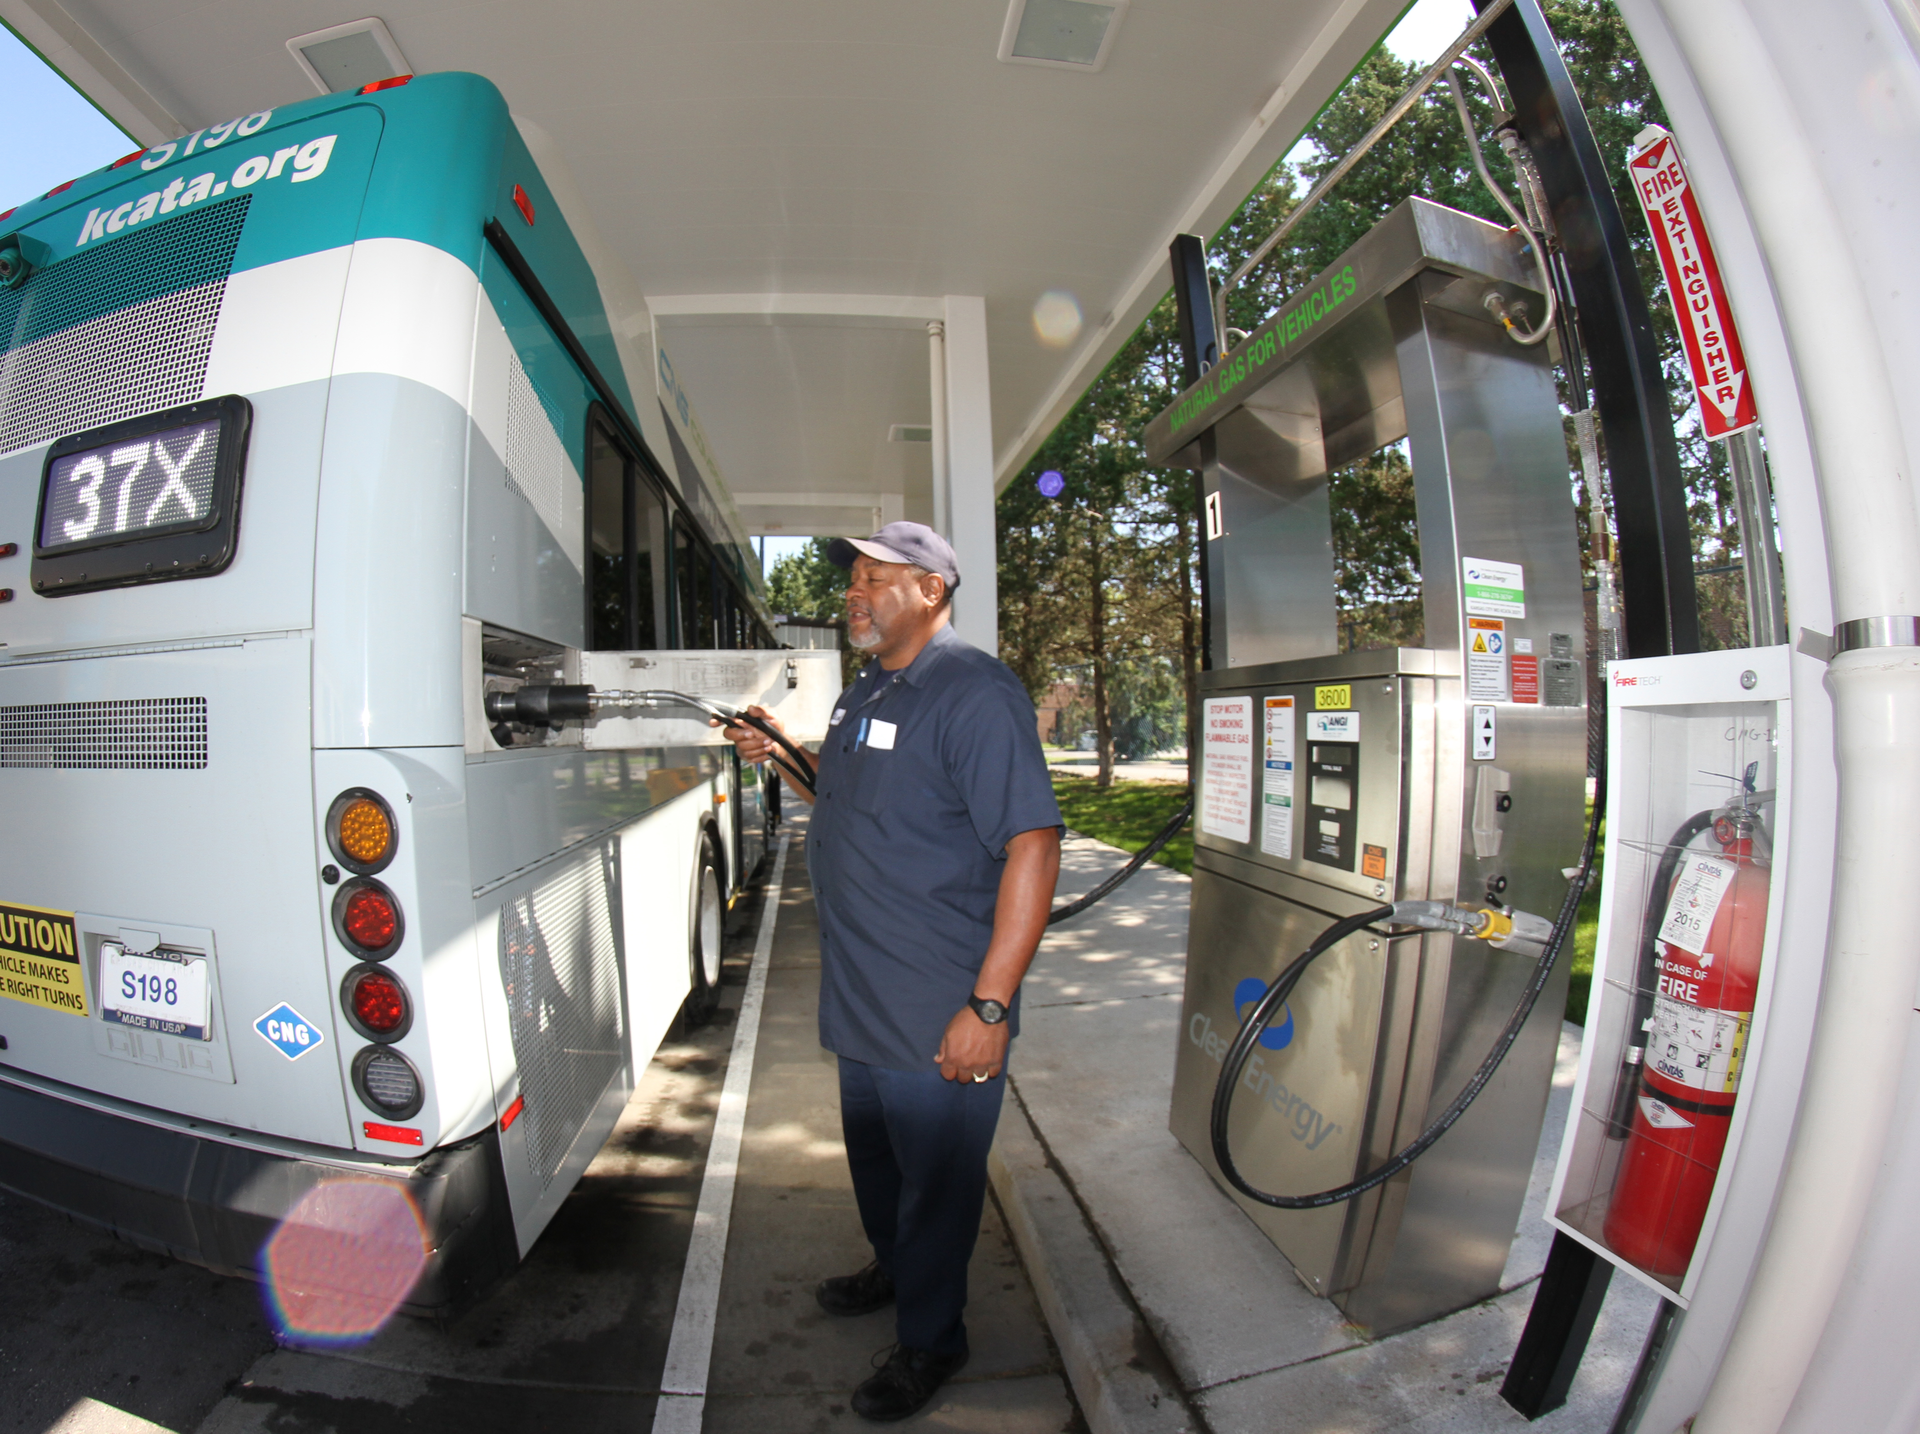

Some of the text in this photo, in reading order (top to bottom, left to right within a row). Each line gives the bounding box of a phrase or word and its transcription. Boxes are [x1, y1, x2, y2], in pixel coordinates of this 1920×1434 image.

[76, 134, 338, 247] kcata.org
[1641, 161, 1684, 205] FIRE
[1662, 196, 1736, 405] EXTINGUISHER
[1169, 265, 1357, 434] NATURAL GAS FOR VEHICLES
[63, 427, 207, 541] 37X
[1208, 494, 1219, 536] 1
[1210, 704, 1243, 714] STOP MOTOR
[1318, 688, 1347, 706] 3600
[1210, 719, 1243, 728] NO SMOKING
[1328, 716, 1348, 726] ANGI
[1205, 732, 1249, 744] FLAMMABLE GAS
[0, 912, 74, 956] UTION
[1673, 911, 1702, 931] 2015
[124, 946, 181, 961] GLIG
[28, 961, 70, 984] MAKES
[1654, 958, 1709, 981] IN CASE OF
[7, 978, 40, 1000] RIGHT
[41, 986, 84, 1010] TURNS
[121, 970, 178, 1005] S198
[1657, 974, 1700, 1003] FIRE
[121, 1013, 147, 1027] MADE
[149, 1019, 160, 1030] IN
[161, 1021, 182, 1034] USA
[266, 1015, 311, 1046] CNG
[106, 1027, 214, 1074] GILLIG
[1732, 1047, 1739, 1058] B
[1189, 1012, 1336, 1151] Clea Energy
